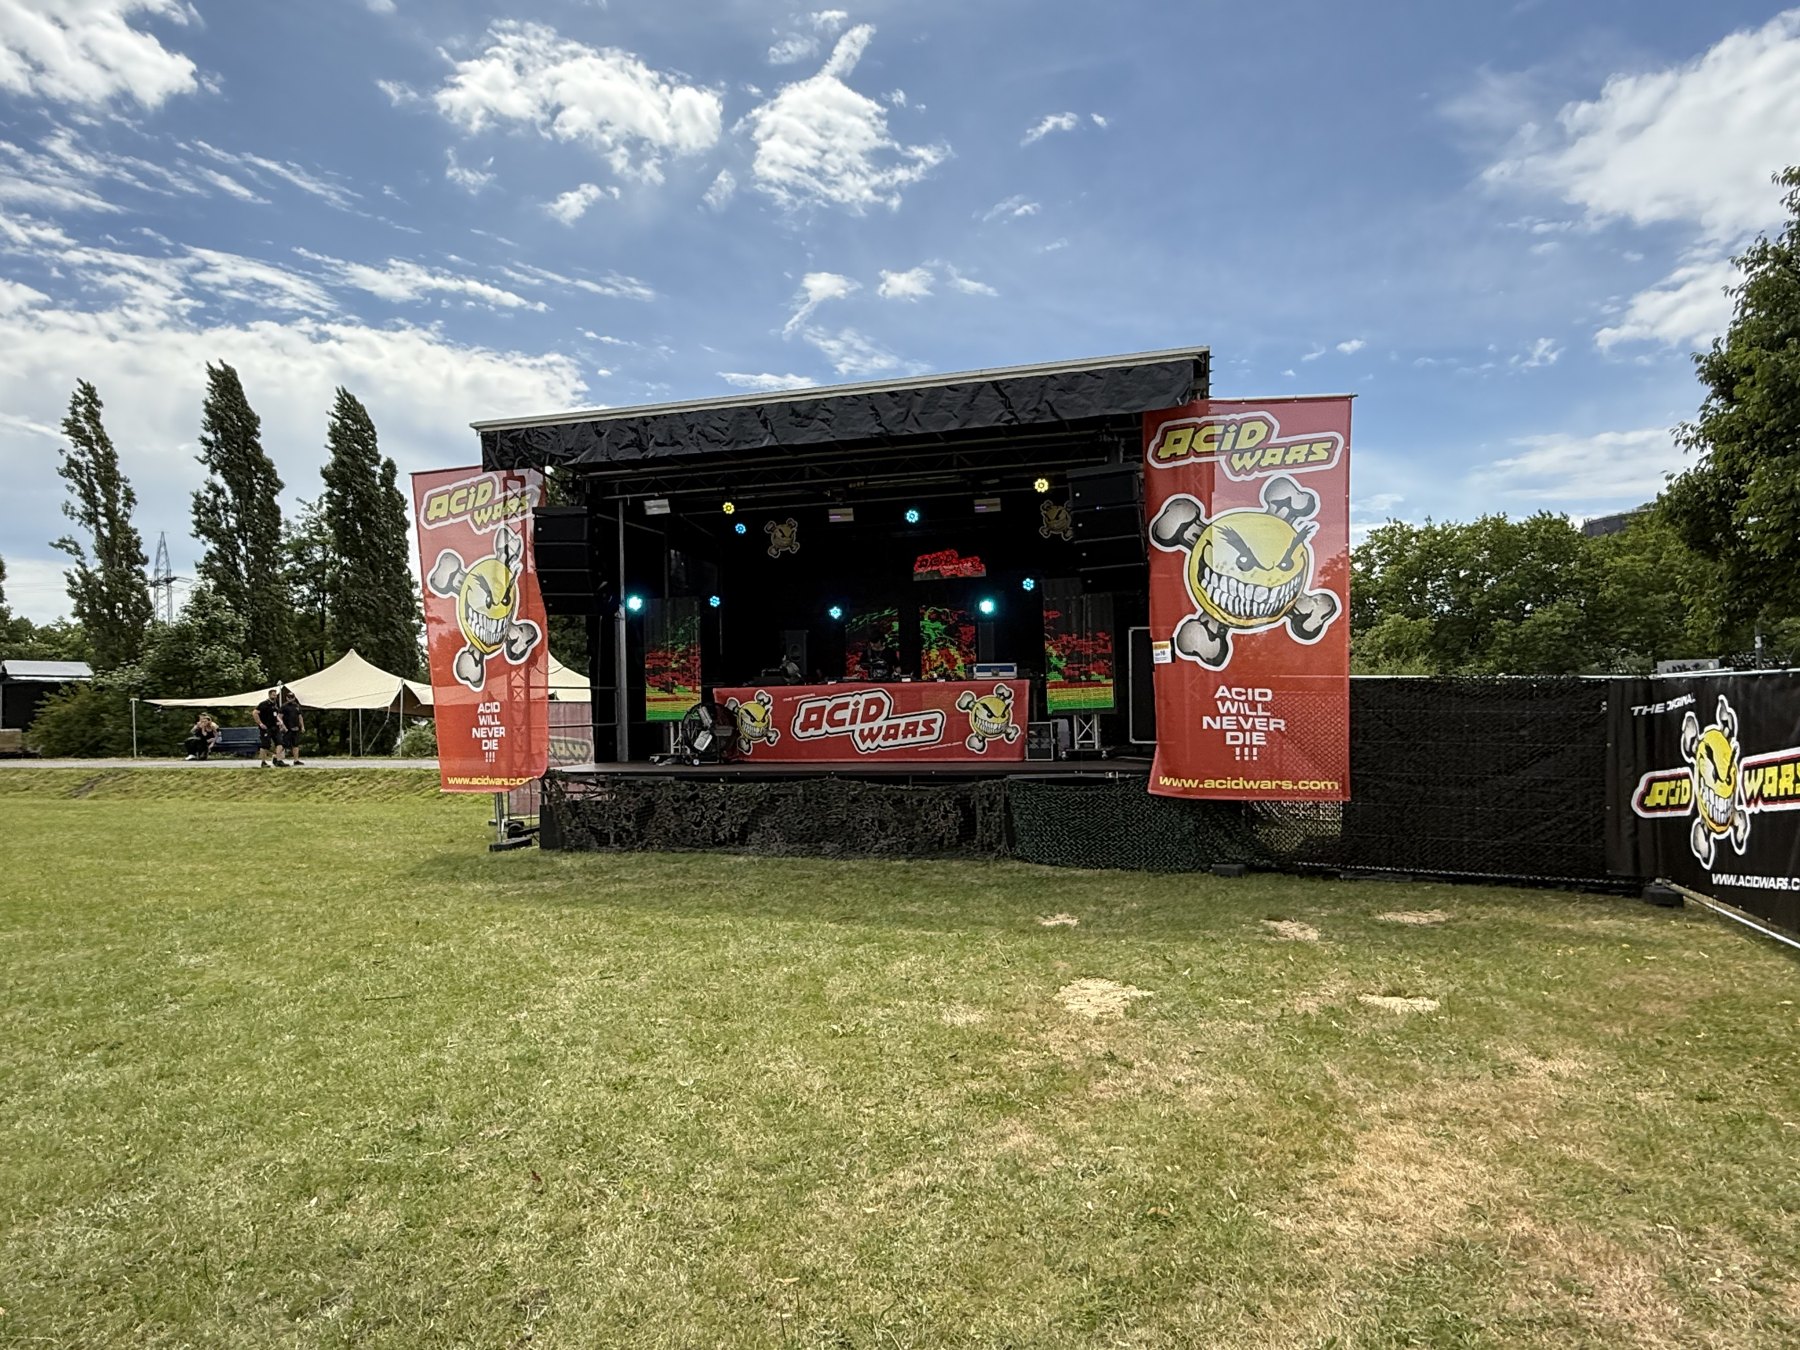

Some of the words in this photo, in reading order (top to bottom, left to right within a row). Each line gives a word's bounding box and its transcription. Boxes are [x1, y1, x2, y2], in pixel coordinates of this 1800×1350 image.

[1230, 441, 1333, 472] WARS
[473, 494, 531, 525] WARS
[1214, 685, 1273, 702] ACID
[477, 702, 500, 713] ACID
[1217, 701, 1271, 716] WILL
[1631, 703, 1665, 716] THE
[478, 714, 500, 726] WILL
[1202, 716, 1286, 731] NEVER
[472, 726, 506, 739] NEVER
[858, 718, 938, 746] WARS
[1226, 732, 1267, 745] DIE
[482, 739, 499, 750] DIE
[1235, 747, 1258, 761] !!!
[1159, 776, 1339, 790] www.acidwars.com
